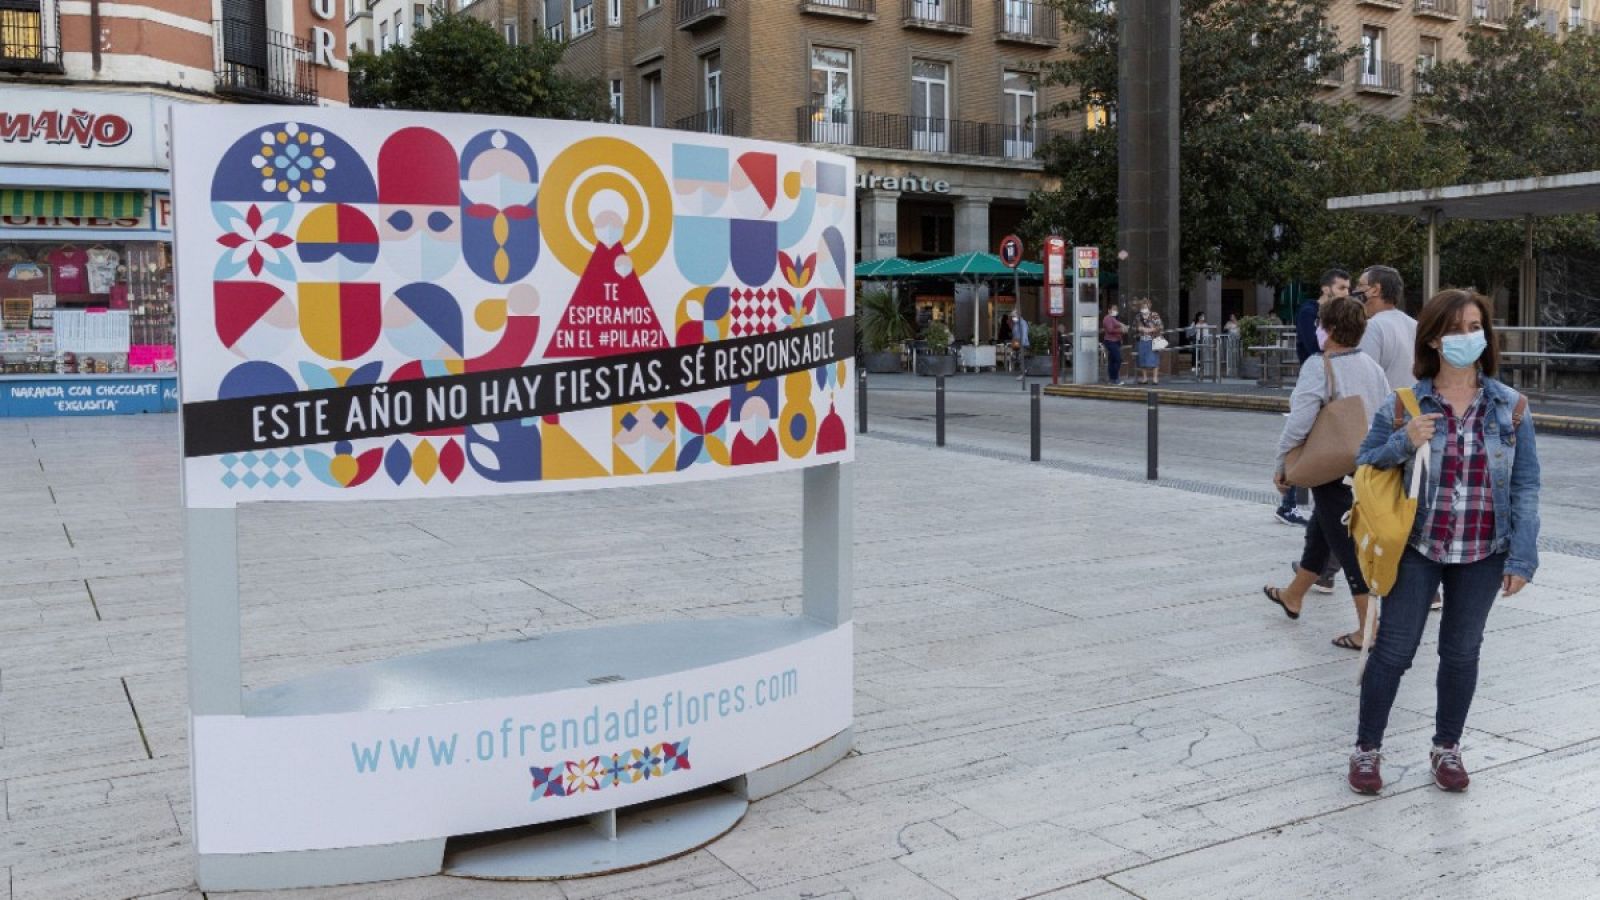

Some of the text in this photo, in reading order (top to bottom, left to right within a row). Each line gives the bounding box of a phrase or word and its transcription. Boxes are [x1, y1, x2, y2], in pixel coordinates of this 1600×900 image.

[603, 282, 619, 301] TE
[568, 306, 652, 325] ESPERAMOS
[556, 329, 574, 348] EN
[579, 329, 594, 348] EL
[68, 385, 92, 396] CON
[96, 383, 158, 396] CHOCOLATE
[252, 328, 835, 442] ESTE AÑO NO HAY FIESTAS. SÉ RESPONSABLE
[351, 667, 798, 773] www.ofrendadeflores.com
